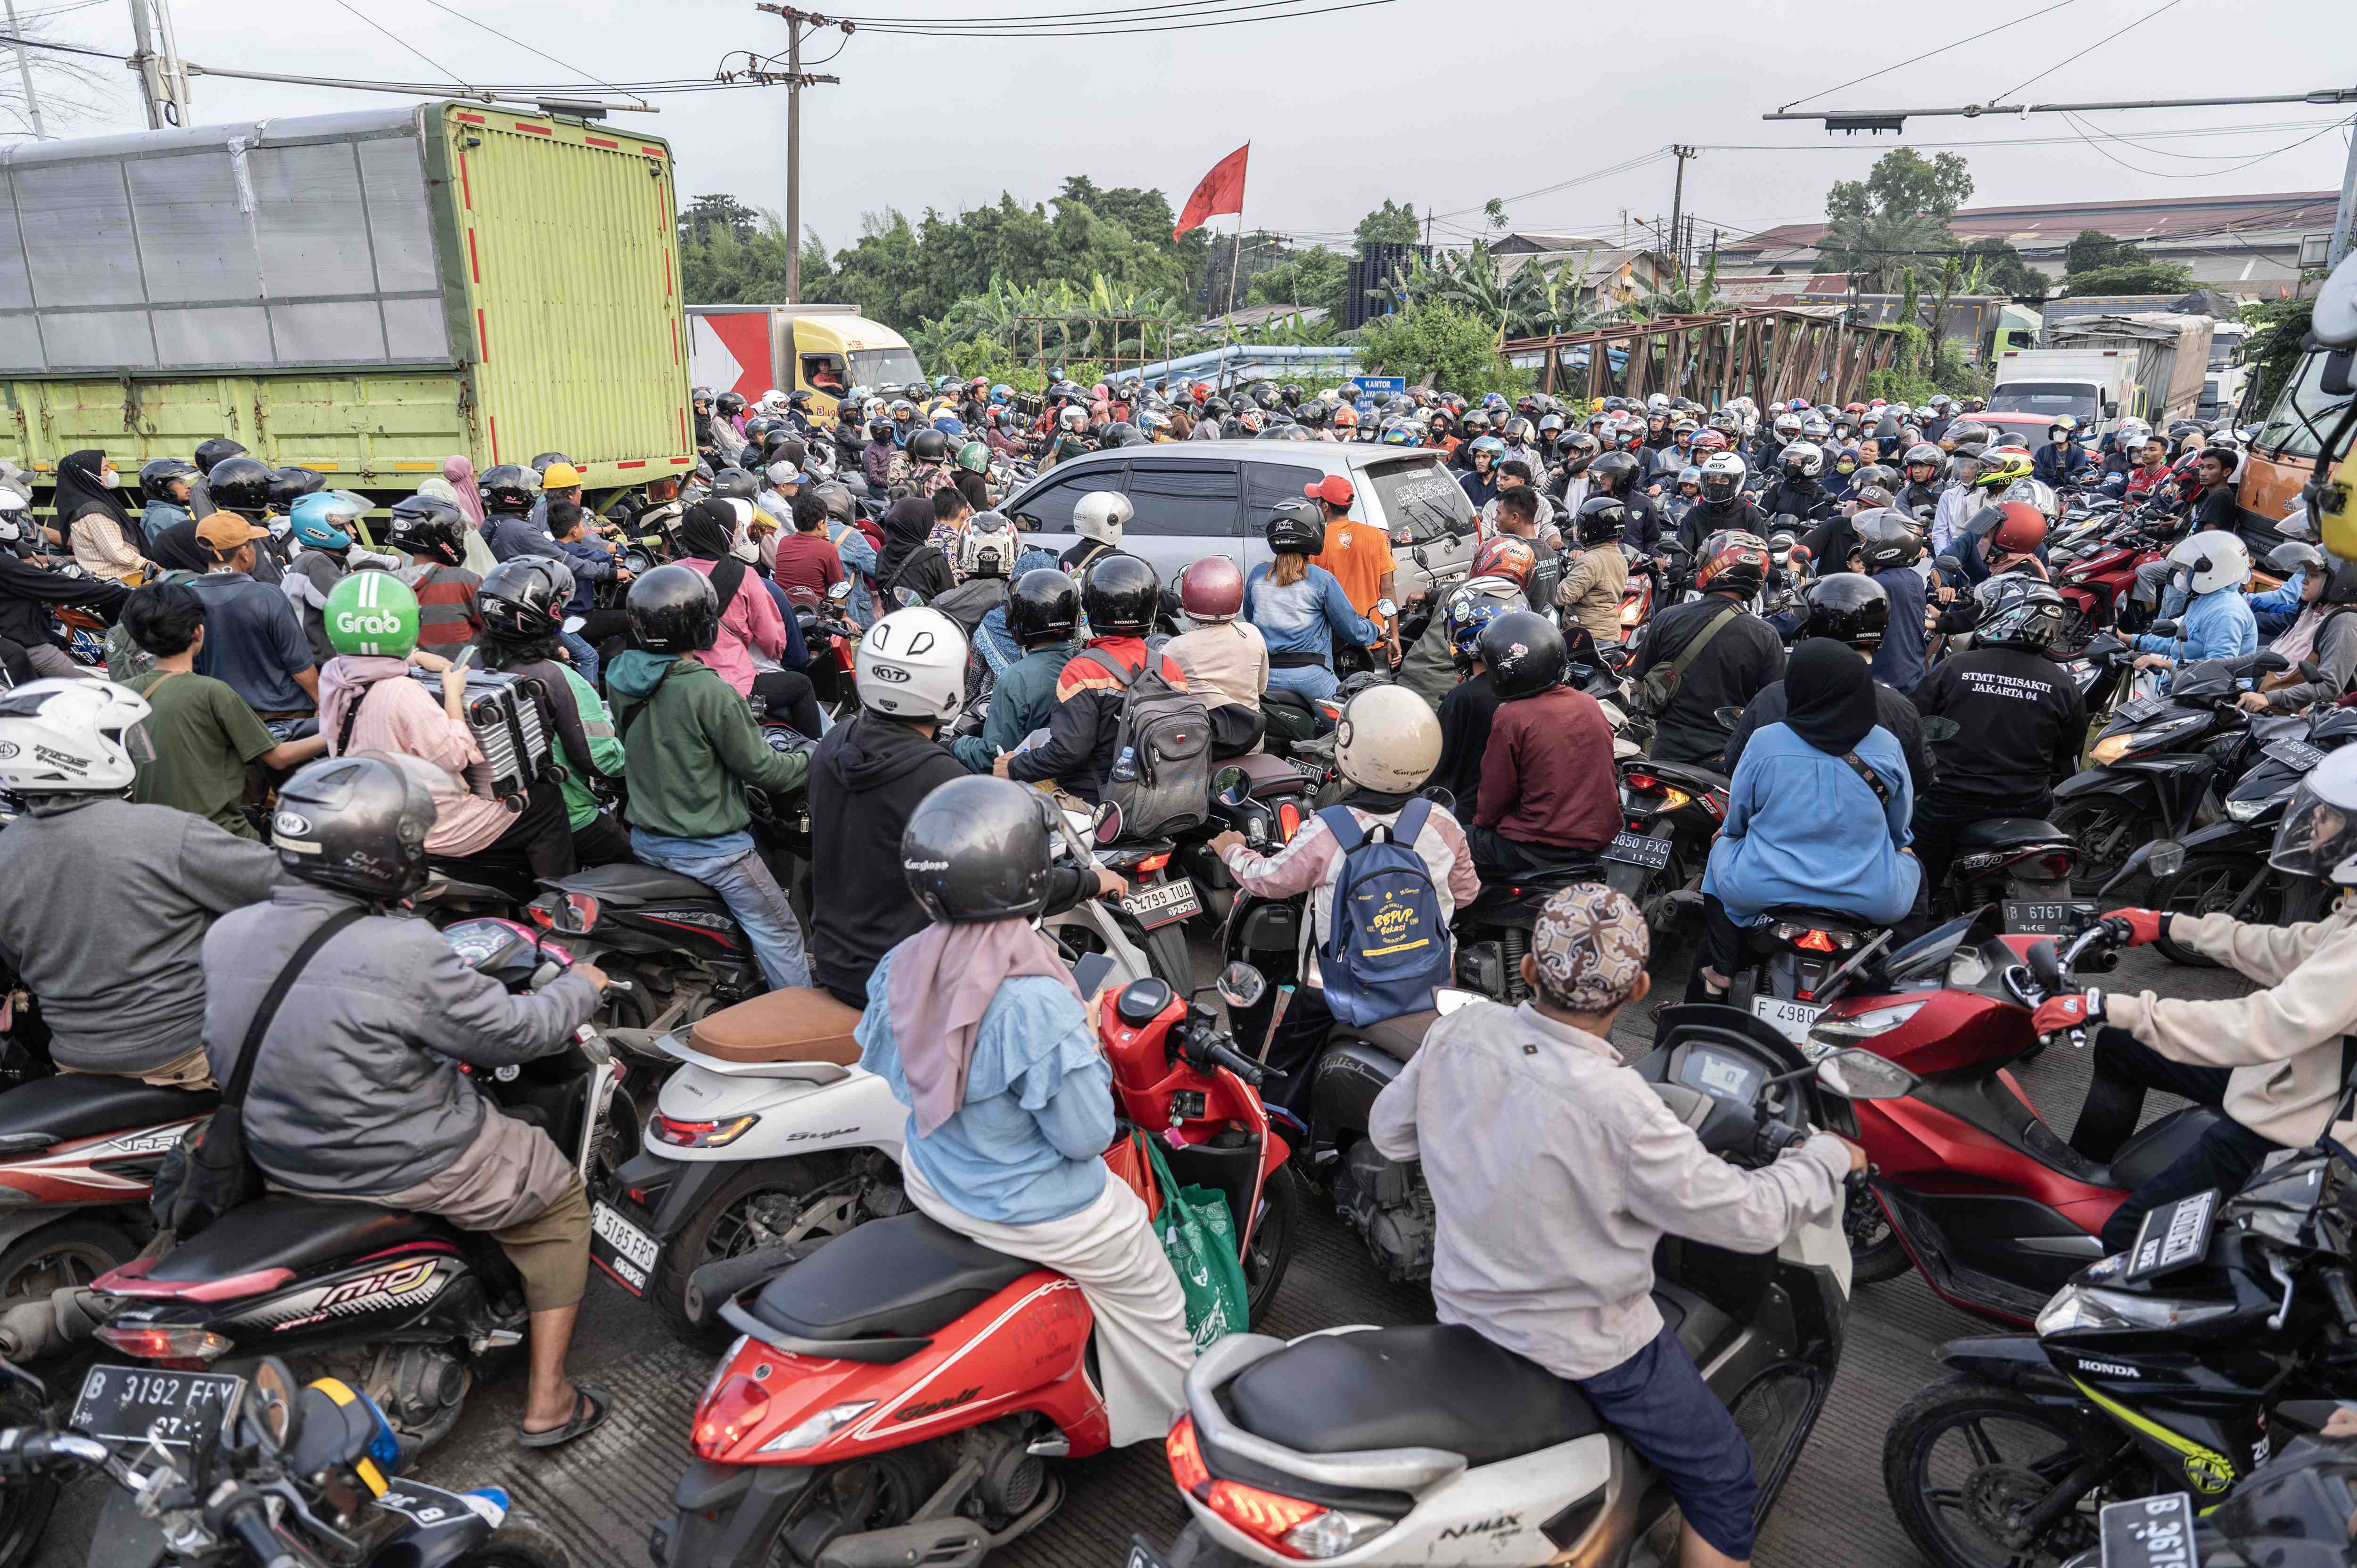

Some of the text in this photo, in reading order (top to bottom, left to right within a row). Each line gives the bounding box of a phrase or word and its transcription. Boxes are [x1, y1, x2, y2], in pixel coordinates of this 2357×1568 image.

[307, 529, 327, 538] INK
[1706, 555, 1730, 578] RIDE
[337, 609, 401, 634] Grab
[873, 666, 906, 680] KYT
[1961, 672, 2052, 693] STMT TRISAKTI
[1972, 683, 2037, 701] JAKARTA 04
[2285, 741, 2308, 754] 5998
[1697, 796, 1718, 814] 125
[1645, 840, 1668, 854] FXC
[352, 850, 379, 865] DJ
[1963, 855, 2003, 869] REVO
[1125, 902, 1134, 913] B
[1140, 891, 1167, 911] 4799
[1169, 884, 1192, 899] TUA
[1379, 905, 1389, 913] OUR
[2009, 906, 2063, 919] B 6767
[1373, 908, 1414, 928] BBPVP
[1380, 923, 1406, 936] Bekasi
[1390, 934, 1407, 943] FUTURE
[1758, 1001, 1815, 1024] F 4980
[106, 1135, 182, 1152] VARI
[603, 1217, 630, 1249] 5185
[631, 1240, 655, 1265] FRS
[2078, 1359, 2141, 1378] HONDA
[85, 1372, 107, 1399] B
[121, 1376, 181, 1406] 3192
[2145, 1498, 2181, 1515] B
